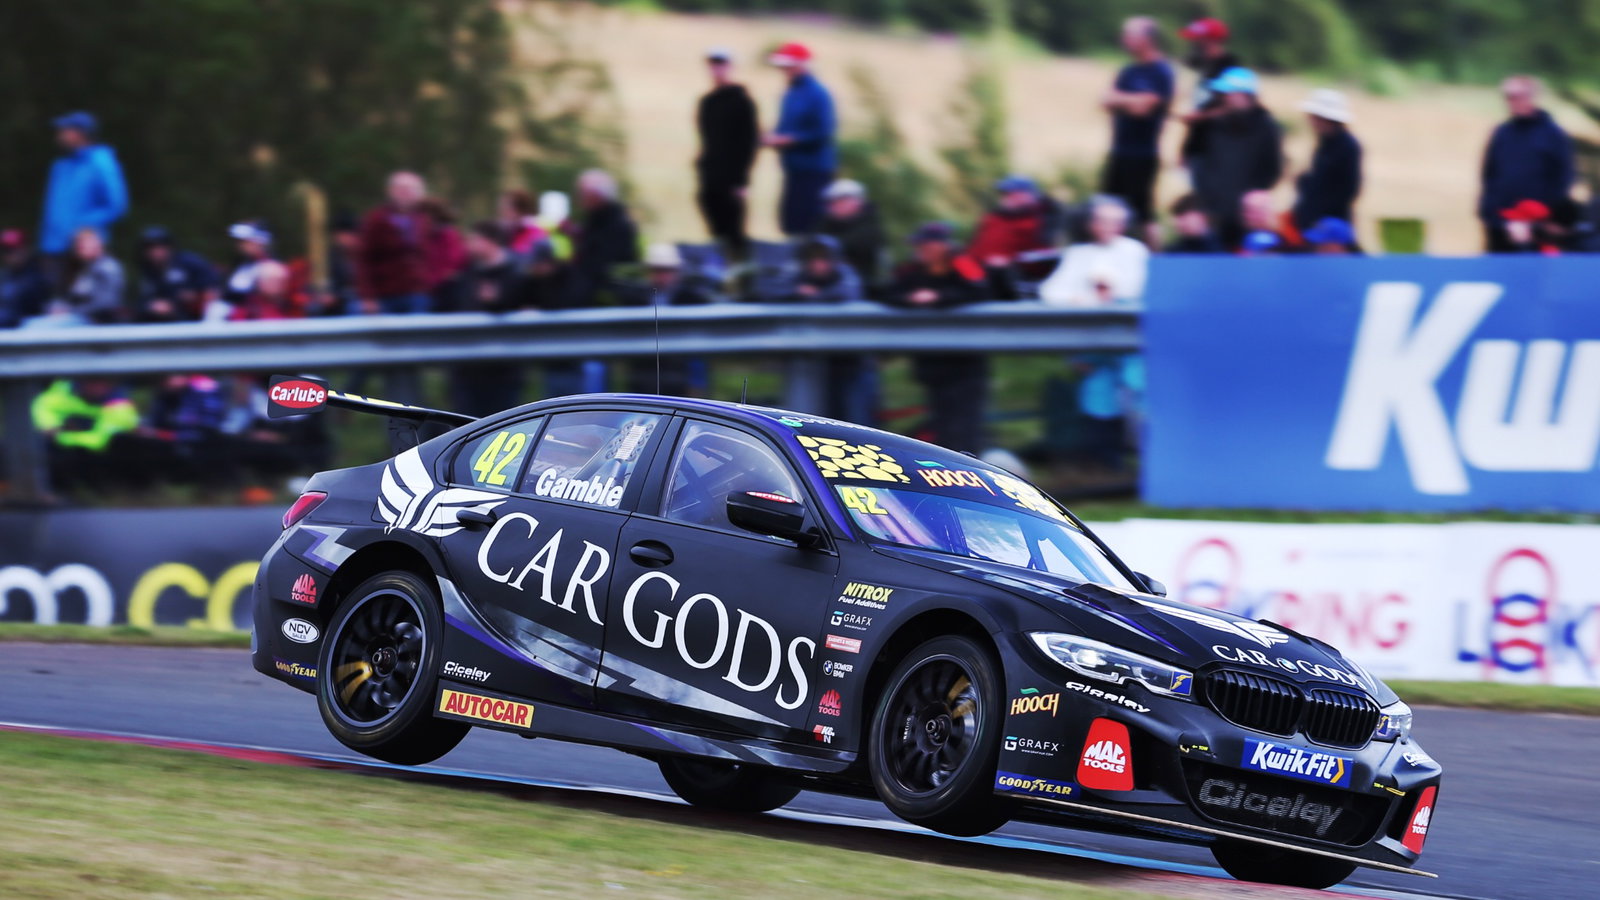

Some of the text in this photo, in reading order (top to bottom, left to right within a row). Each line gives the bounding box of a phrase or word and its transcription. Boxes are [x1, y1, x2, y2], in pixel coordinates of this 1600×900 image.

[271, 386, 325, 403] Carlube
[473, 431, 526, 486] 42
[535, 468, 624, 507] Gamble
[916, 469, 998, 497] HOOCH
[841, 487, 889, 515] 42
[292, 573, 317, 596] MAC
[842, 582, 894, 602] NITROX
[291, 592, 316, 604] TOOLS
[838, 596, 887, 610] Fuel Additives
[477, 512, 816, 710] CAR GODS
[843, 613, 873, 626] GRAFX
[288, 622, 312, 635] NCV
[1212, 645, 1279, 668] CAR
[444, 661, 491, 682] Ciceley
[445, 692, 529, 725] AUTOCAR
[820, 689, 842, 709] MAC
[1010, 693, 1060, 718] HOOCH
[818, 706, 841, 717] TOOLS
[1018, 738, 1059, 752] GRAFX
[1083, 740, 1126, 765] MAC
[1083, 757, 1125, 774] TOOLS
[1199, 778, 1343, 837] Ciceley
